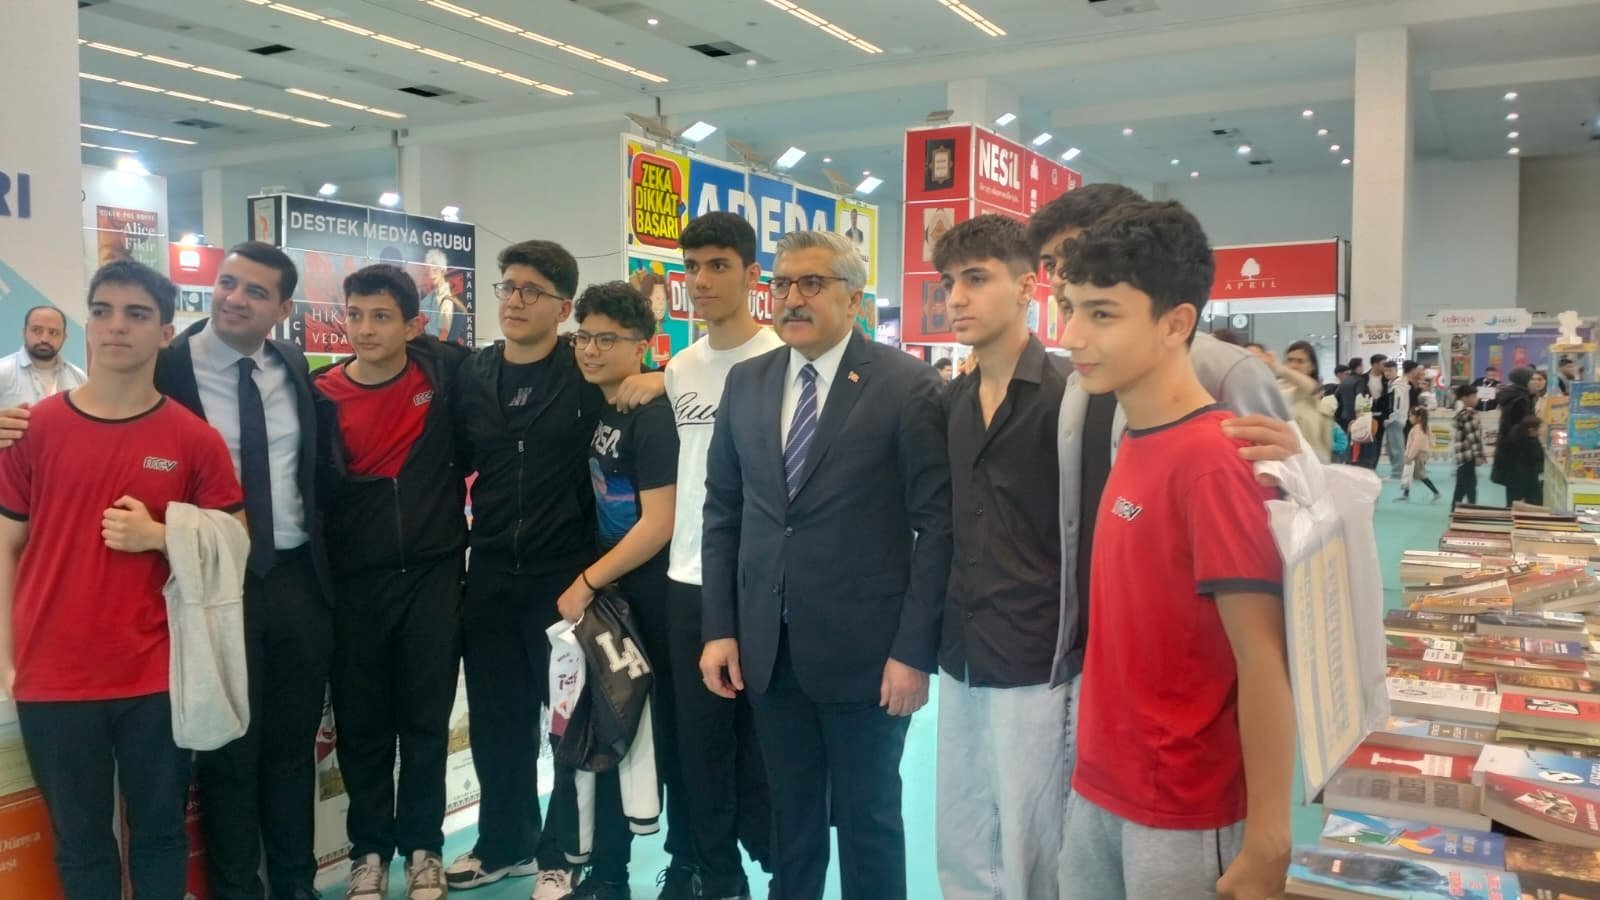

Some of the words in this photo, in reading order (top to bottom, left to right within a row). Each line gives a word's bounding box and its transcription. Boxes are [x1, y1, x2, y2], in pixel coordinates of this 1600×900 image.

[642, 163, 673, 193] ZEKA
[123, 222, 156, 234] Alice
[290, 211, 359, 237] DESTEK
[363, 222, 419, 245] MEDYA
[422, 230, 472, 252] GRUBU
[1225, 280, 1277, 291] APRIL
[595, 632, 650, 680] LA
